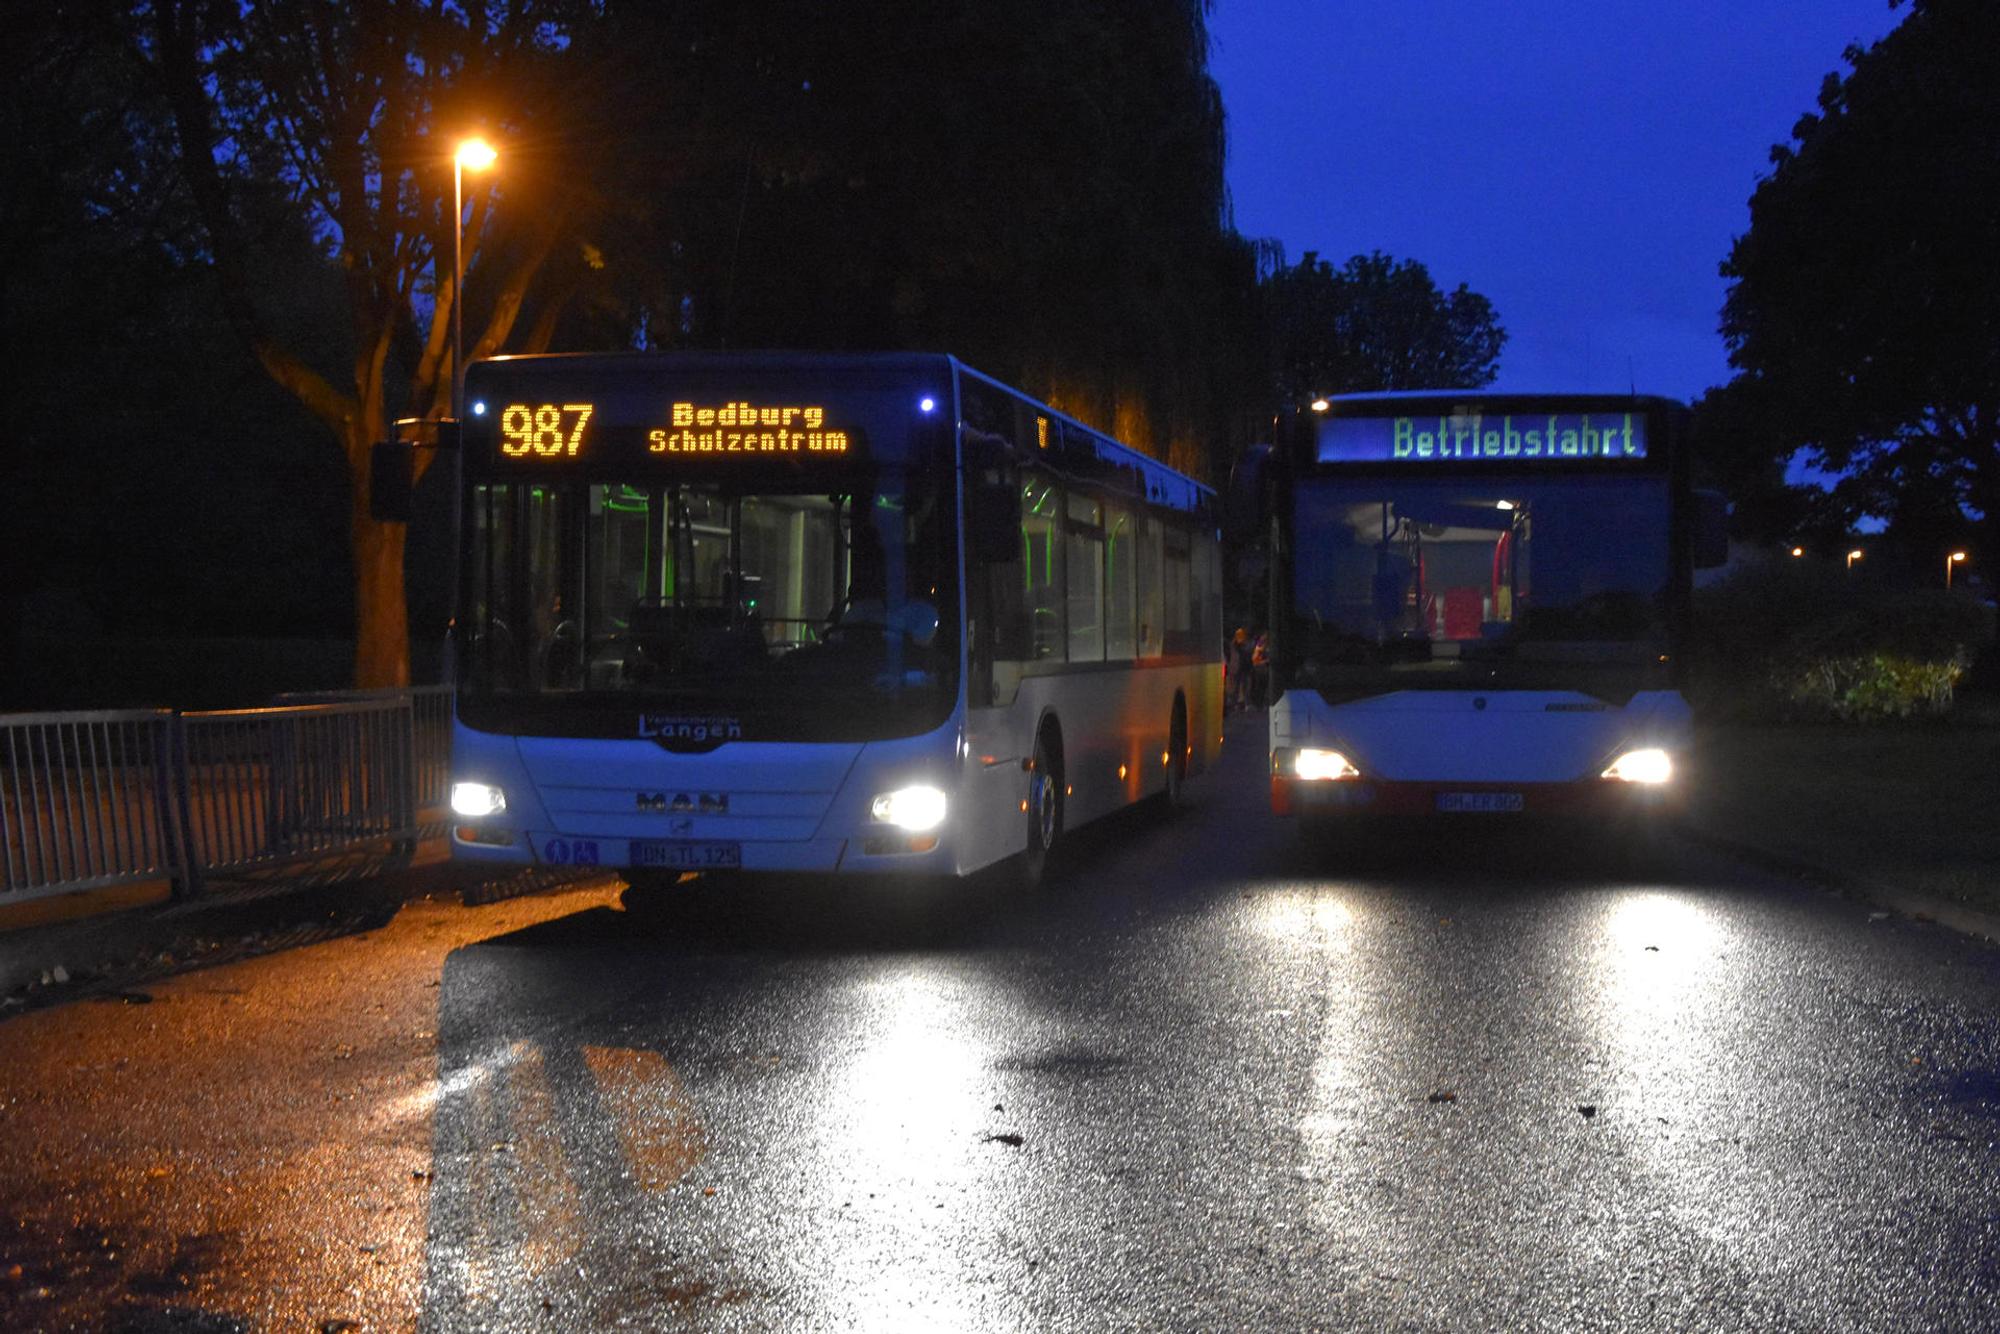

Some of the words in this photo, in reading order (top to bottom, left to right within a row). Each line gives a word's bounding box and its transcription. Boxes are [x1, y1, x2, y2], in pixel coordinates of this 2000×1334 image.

[673, 402, 823, 428] Bedburg
[503, 405, 593, 456] 987
[649, 429, 848, 452] Schulzentrum
[1393, 413, 1637, 457] Betriebsfahrt
[638, 713, 741, 741] Langen
[636, 792, 729, 814] MAN
